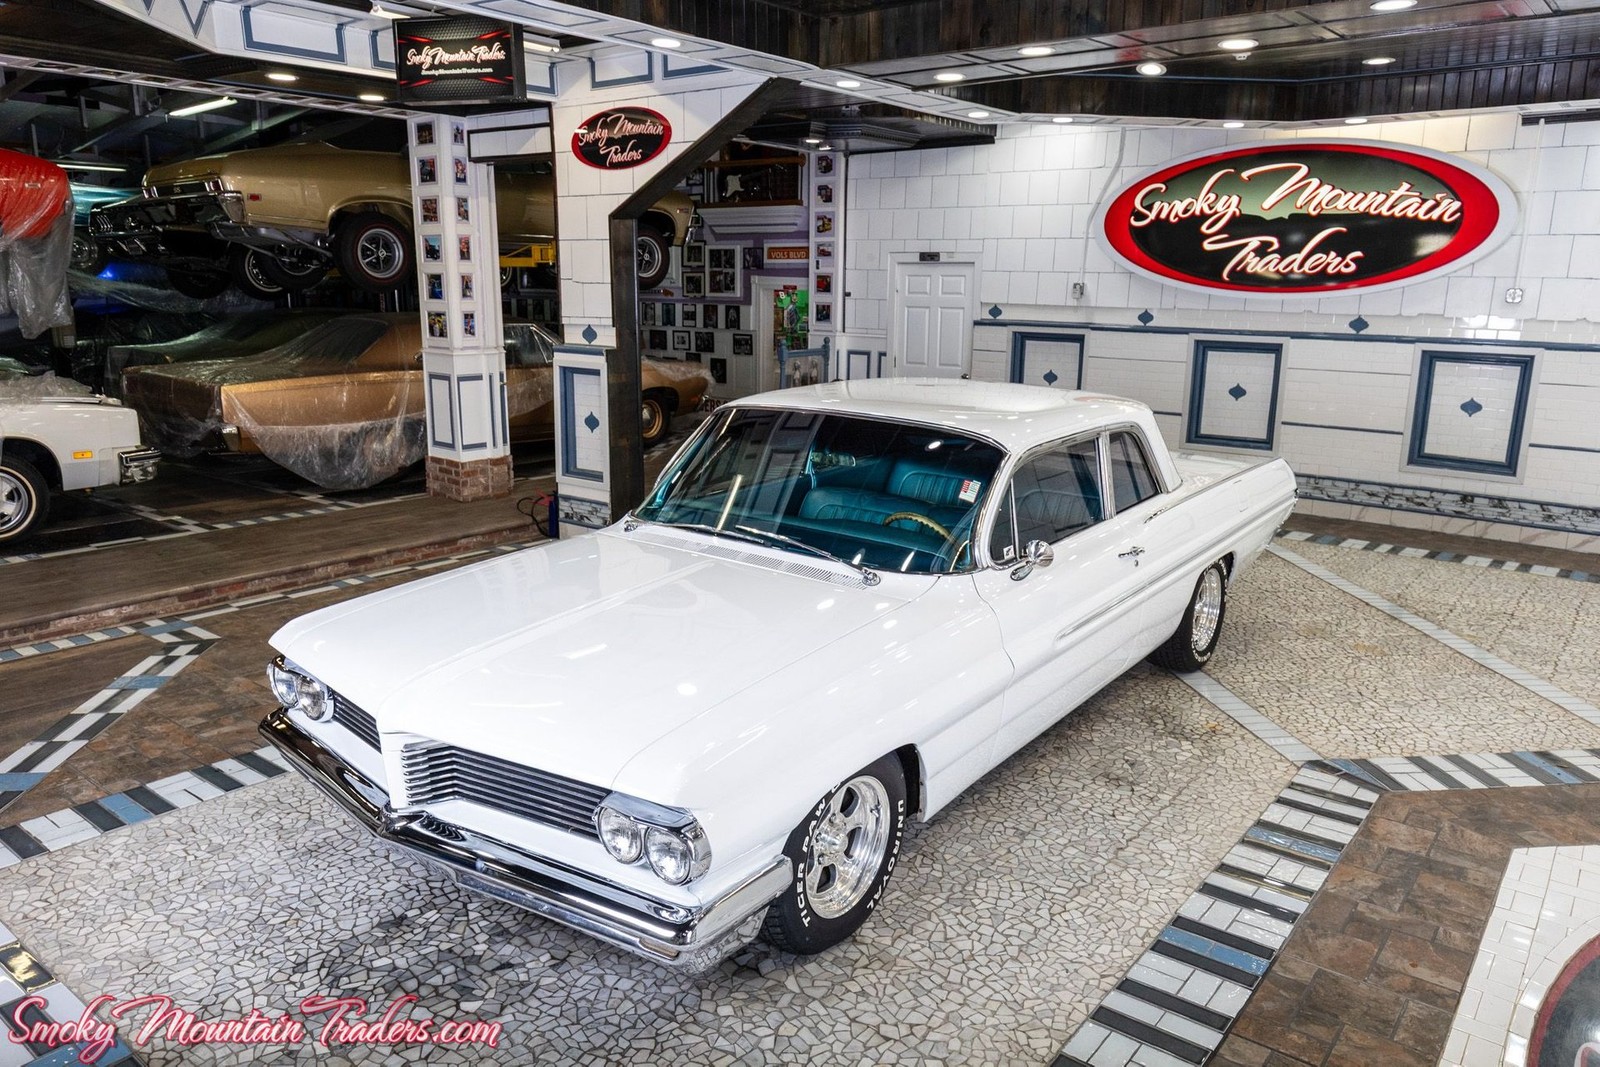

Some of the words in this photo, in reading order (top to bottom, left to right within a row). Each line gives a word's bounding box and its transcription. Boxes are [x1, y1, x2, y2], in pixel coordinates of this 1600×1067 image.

[578, 117, 609, 147] Smoky
[607, 113, 664, 137] Mountain
[600, 140, 642, 167] Traders
[1130, 168, 1241, 234] Smoky
[1240, 162, 1463, 223] Mountain
[771, 251, 788, 259] VOLS
[789, 251, 807, 259] BLVD
[1202, 227, 1364, 281] Traders
[802, 798, 826, 853] PAW
[867, 799, 904, 909] UNIROYAL
[796, 863, 811, 927] TIGER
